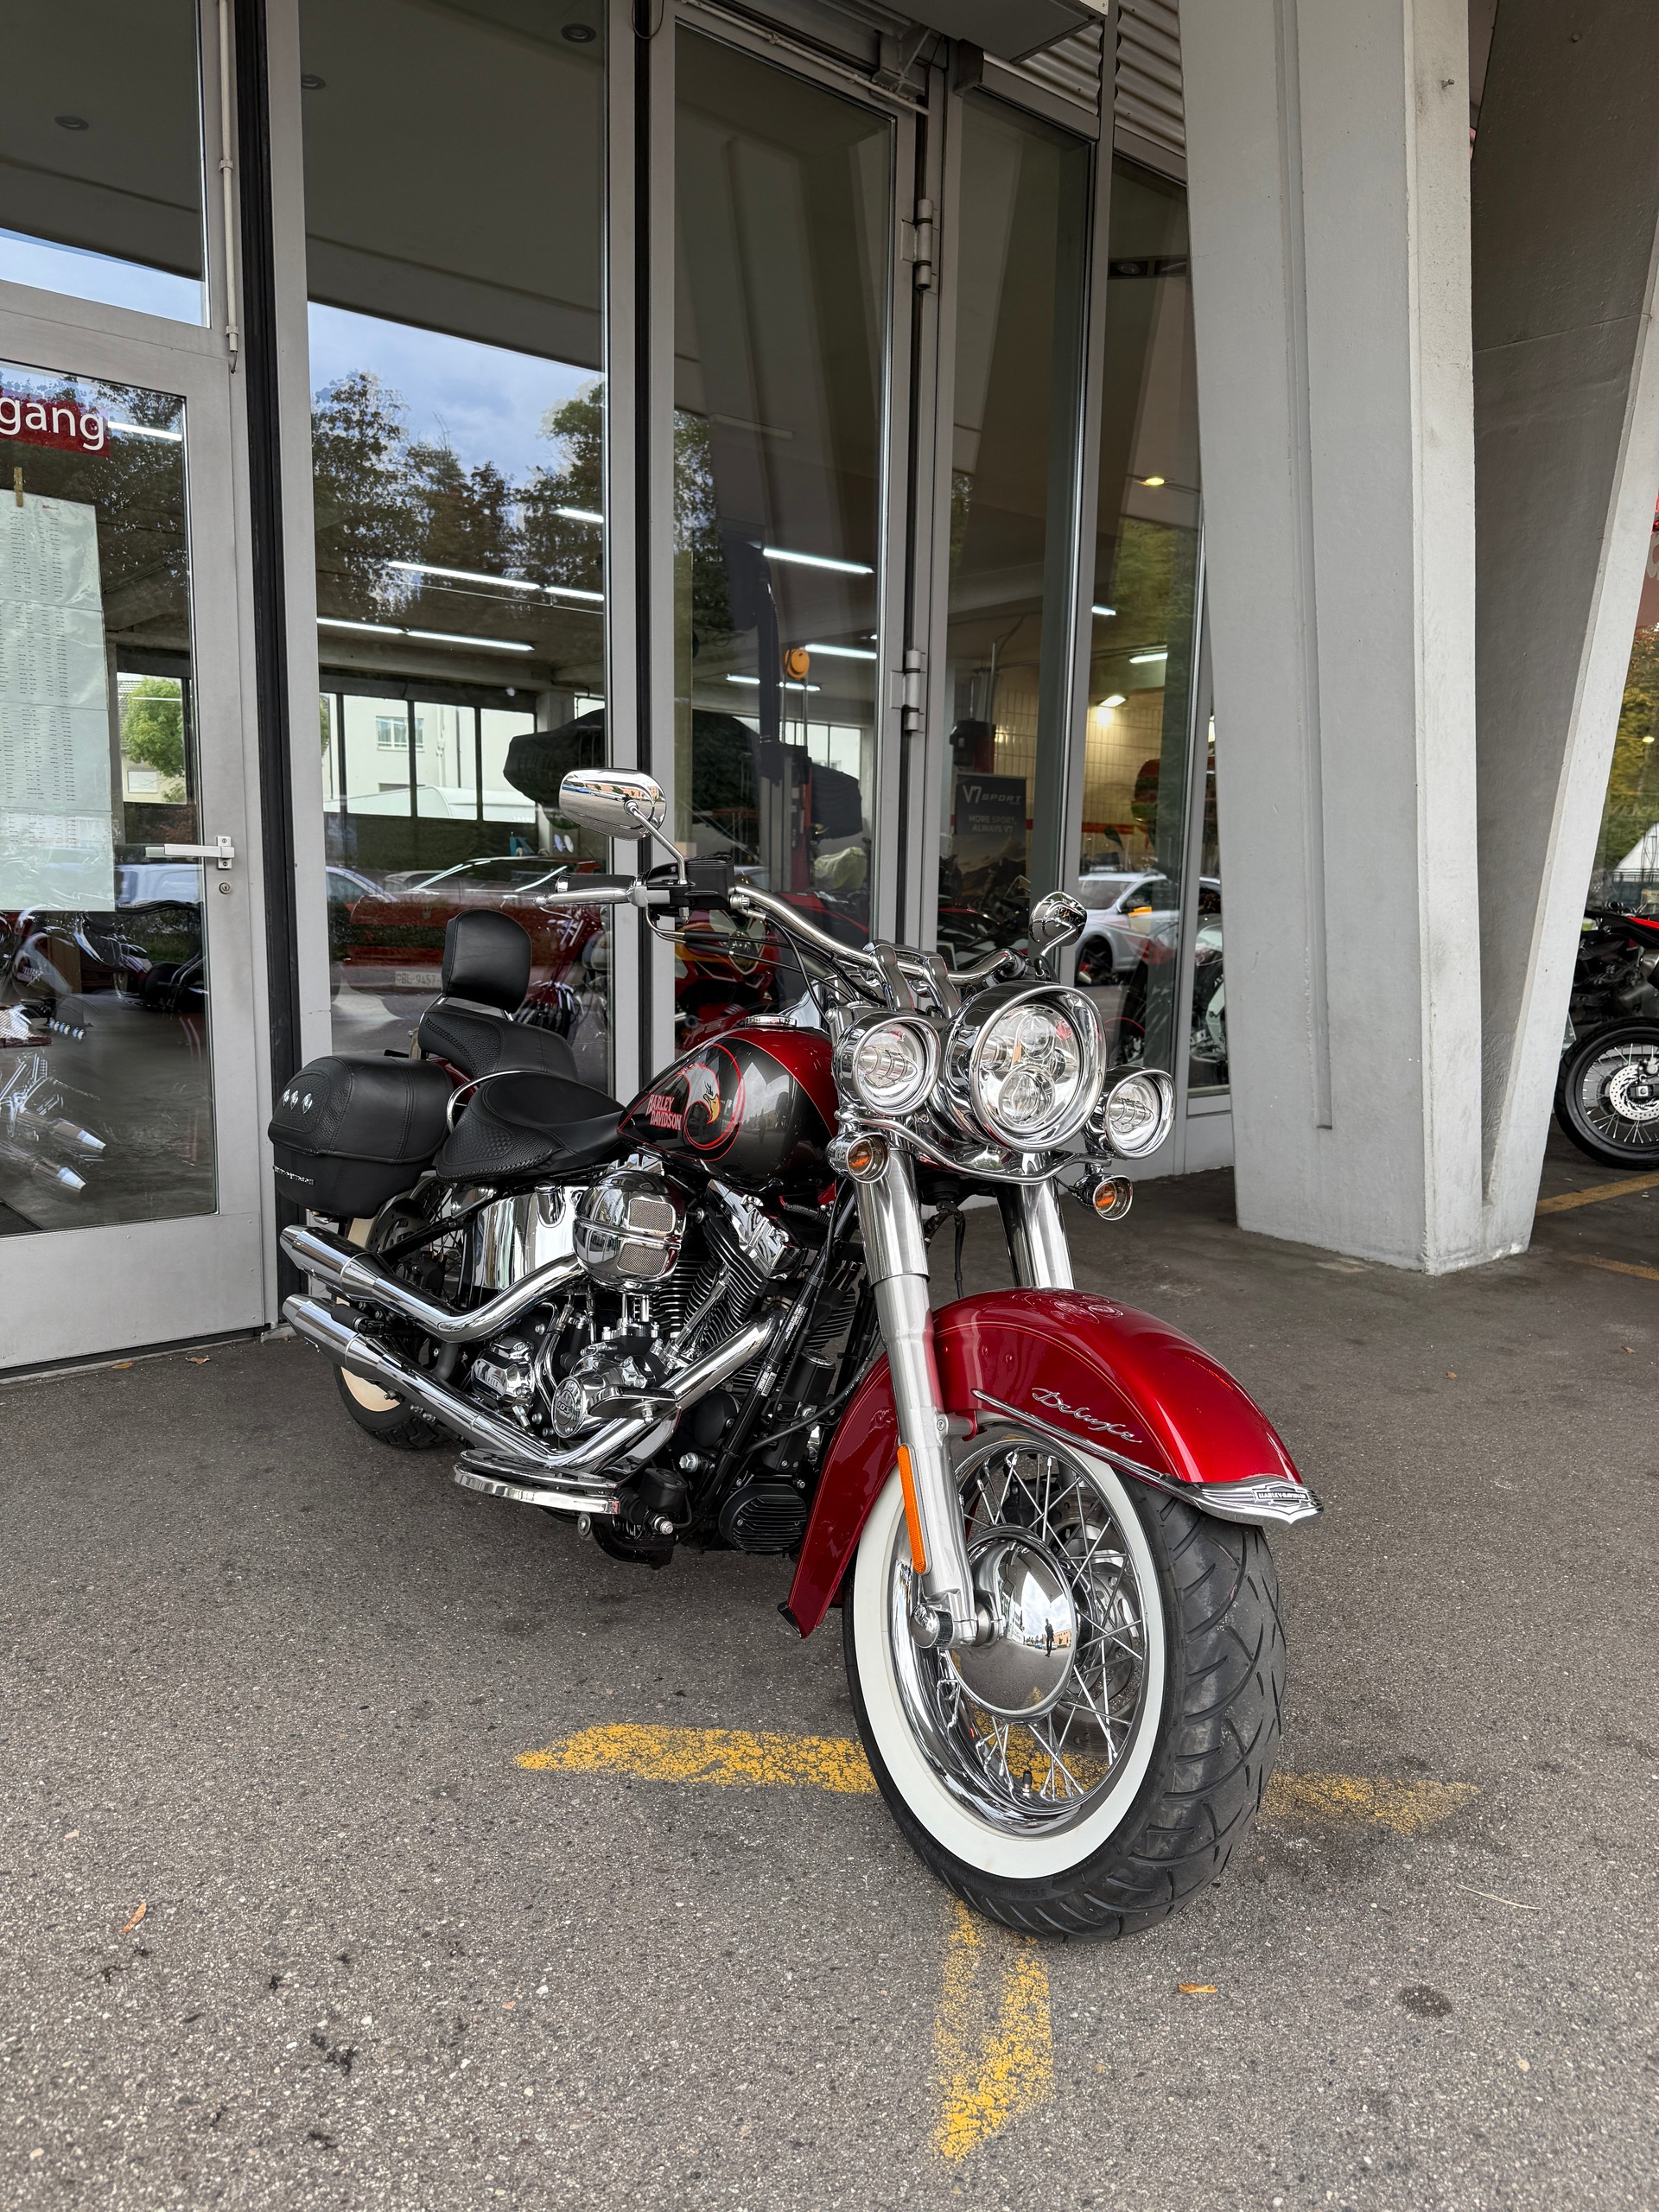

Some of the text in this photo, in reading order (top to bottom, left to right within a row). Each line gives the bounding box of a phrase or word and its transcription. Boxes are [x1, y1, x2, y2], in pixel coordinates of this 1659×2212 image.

[0, 397, 105, 450] gang
[962, 785, 1022, 804] V7 SPORT
[968, 815, 990, 823] MORE
[971, 823, 1002, 832] ALWAYS
[645, 1094, 675, 1116] HARLEY
[649, 1109, 683, 1130] DAVIDSON
[1031, 1387, 1143, 1444] Deluxe
